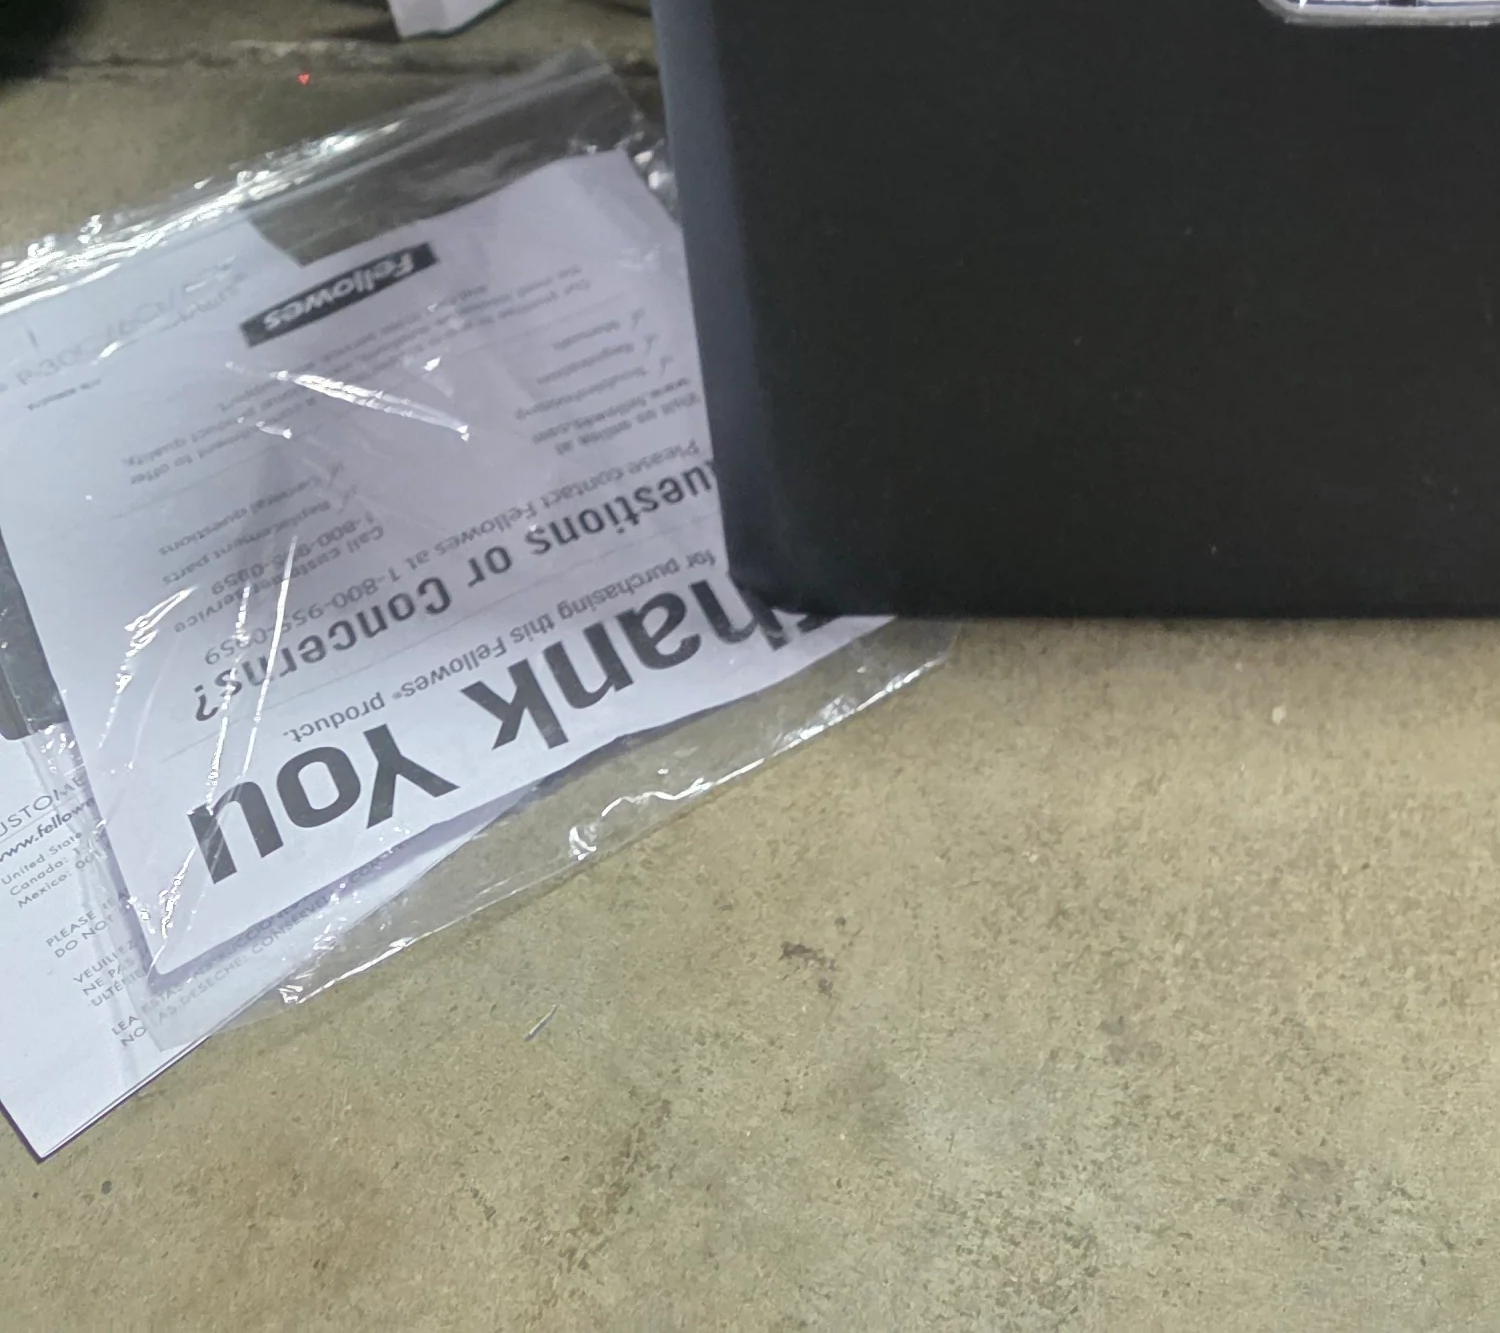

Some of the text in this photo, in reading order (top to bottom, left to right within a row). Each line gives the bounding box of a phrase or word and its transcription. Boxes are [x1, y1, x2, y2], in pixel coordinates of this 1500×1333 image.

[256, 246, 419, 337] Fellowes
[539, 467, 626, 510] contact
[434, 501, 539, 556] Fellowes
[405, 549, 431, 572] at
[686, 549, 717, 570] for
[194, 467, 711, 723] uestions or Concerns?
[556, 557, 682, 621] purchasing
[509, 612, 556, 645] this
[184, 576, 850, 885] hank You
[283, 691, 386, 744] product.
[0, 792, 99, 864] ww.fellowe
[0, 853, 47, 886] United
[9, 860, 65, 897] Canada:
[17, 874, 69, 909] Mexico:
[45, 910, 96, 948] PLEASE
[54, 914, 113, 960] DO NOT
[82, 977, 106, 997] NE
[111, 1015, 140, 1037] LEA
[120, 1026, 148, 1049] NO
